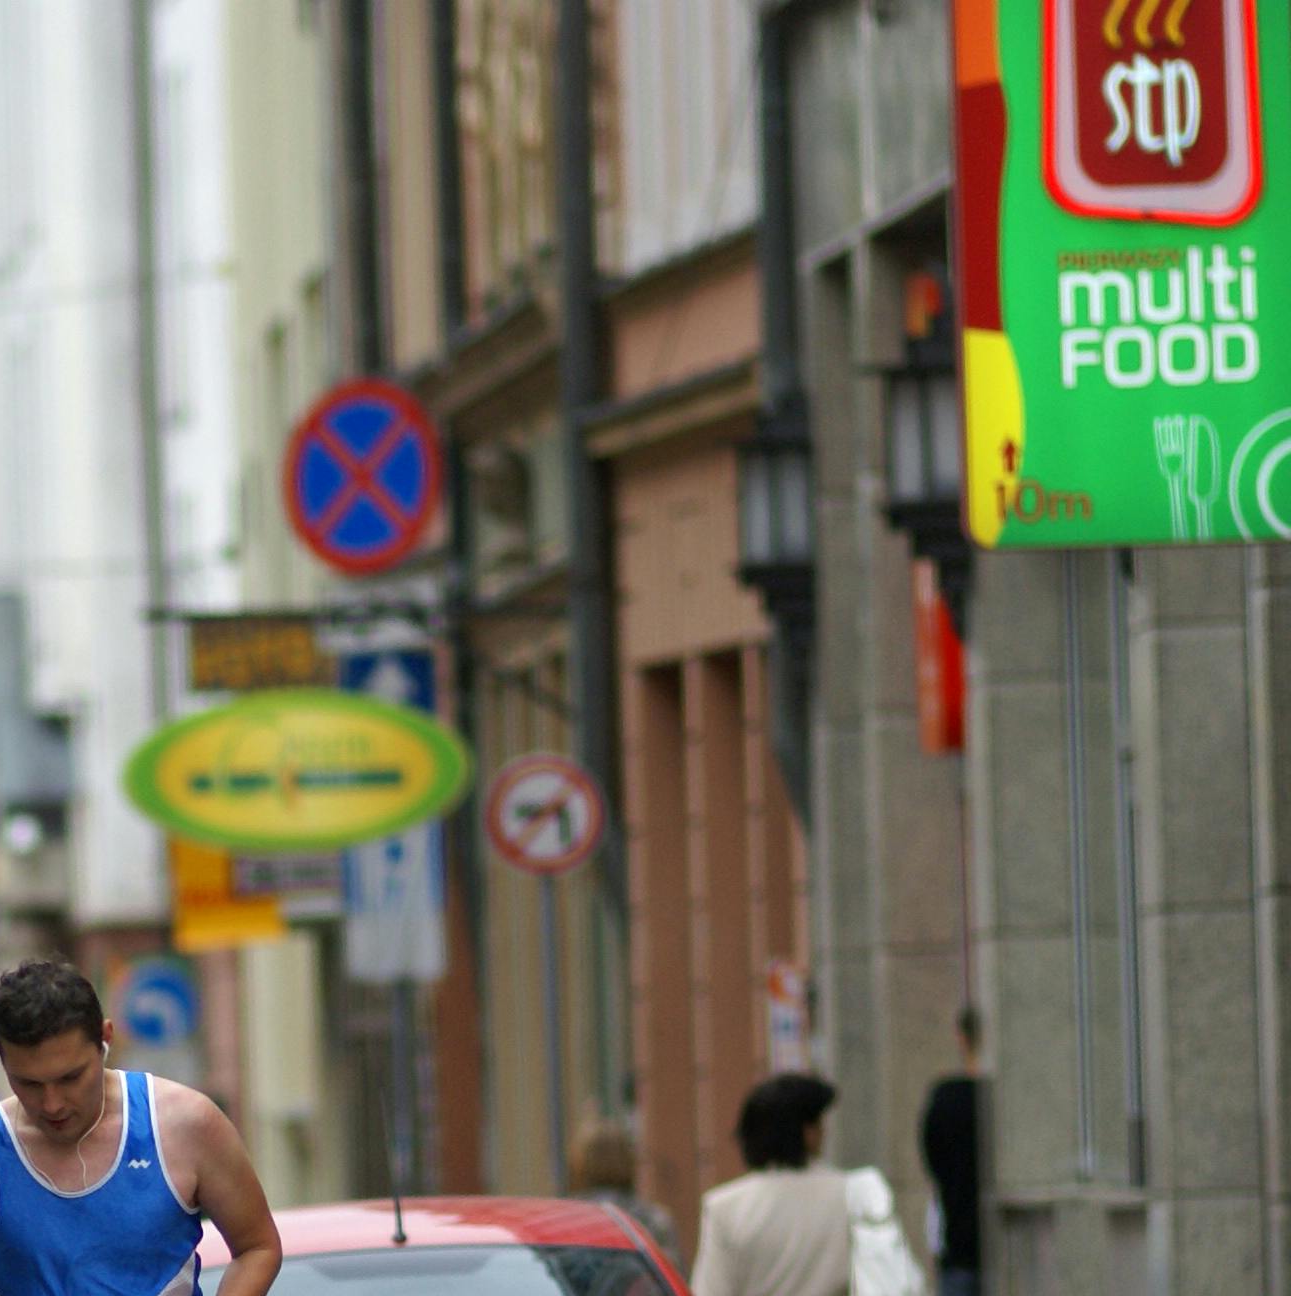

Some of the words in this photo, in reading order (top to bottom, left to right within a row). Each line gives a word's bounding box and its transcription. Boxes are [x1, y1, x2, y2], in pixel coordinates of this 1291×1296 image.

[1103, 53, 1201, 166] stp
[1059, 244, 1257, 327] multi
[1061, 323, 1259, 389] FOOD
[994, 478, 1094, 525] 10m
